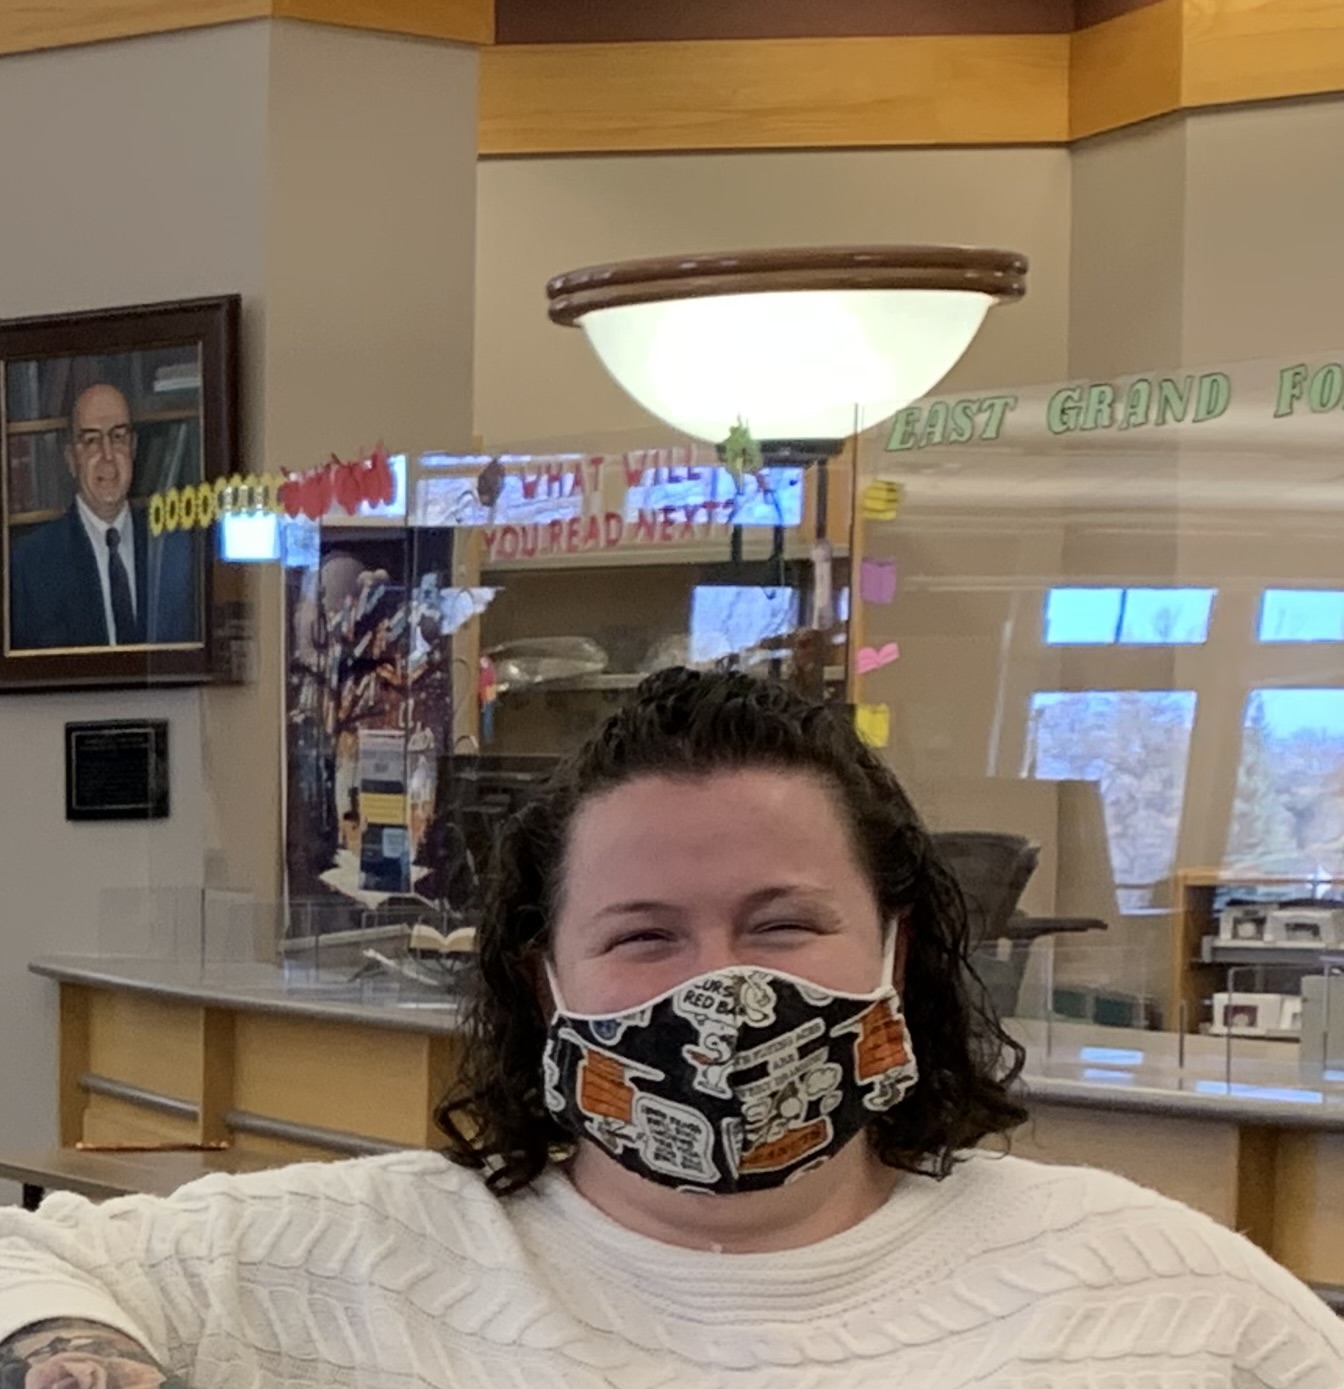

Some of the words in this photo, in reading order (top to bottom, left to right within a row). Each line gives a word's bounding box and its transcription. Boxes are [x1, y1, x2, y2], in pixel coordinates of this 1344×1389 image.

[885, 395, 1019, 452] EAST
[1046, 371, 1231, 435] GRAND
[1273, 362, 1344, 419] FO
[520, 456, 605, 499] WHAT
[624, 443, 703, 487] WILL
[482, 522, 538, 562] YOU
[549, 512, 623, 553] READ
[684, 990, 713, 1009] RED
[695, 979, 735, 997] URS
